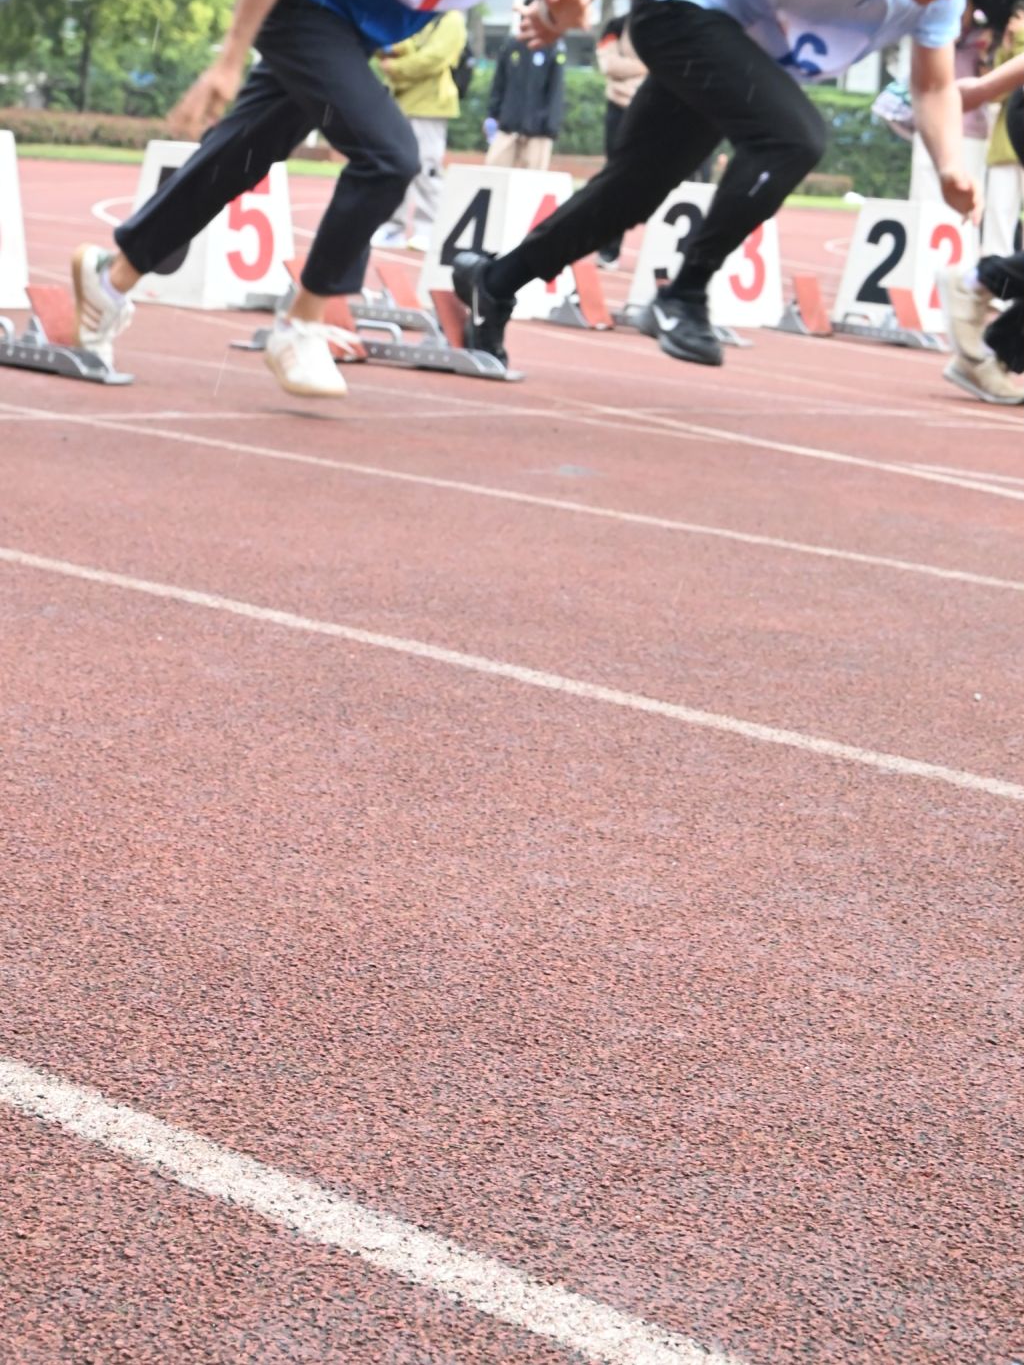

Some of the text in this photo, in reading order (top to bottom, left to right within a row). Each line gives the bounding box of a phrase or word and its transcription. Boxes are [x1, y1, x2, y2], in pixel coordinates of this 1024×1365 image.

[226, 174, 274, 282] 5
[440, 188, 492, 266] 4
[728, 222, 766, 302] 3
[856, 219, 907, 305] 2
